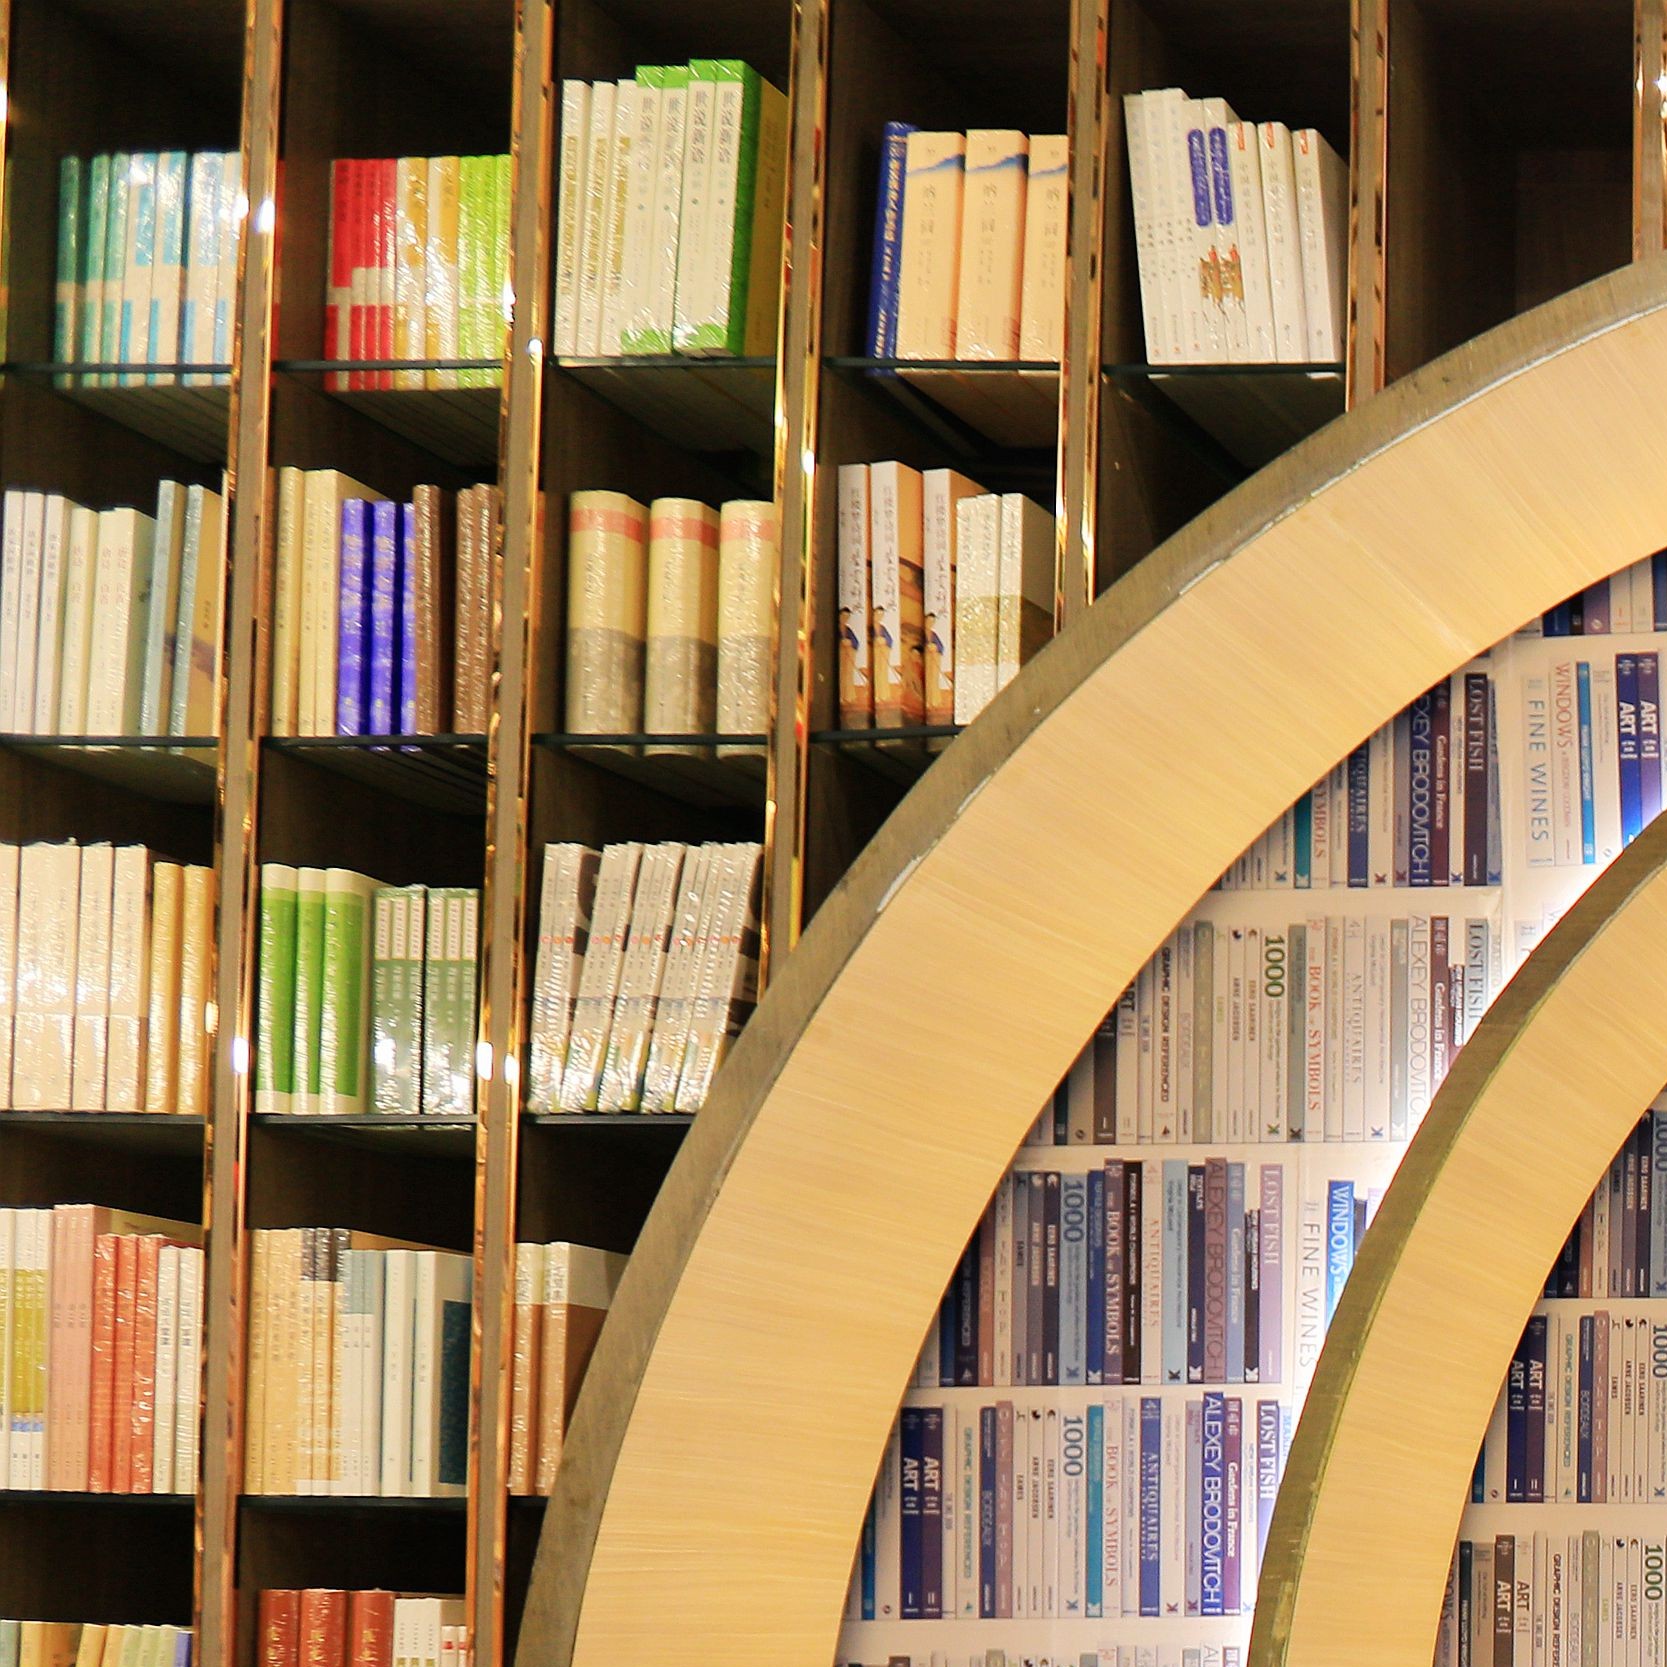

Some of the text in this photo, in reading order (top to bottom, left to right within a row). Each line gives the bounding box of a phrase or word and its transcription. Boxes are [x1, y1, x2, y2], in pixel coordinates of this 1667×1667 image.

[1469, 673, 1485, 770] LOST FISH
[1554, 663, 1572, 748] WINDOWS
[1620, 702, 1636, 736] ART
[1641, 700, 1657, 737] ART
[1529, 699, 1548, 842] FINE WINES
[1265, 936, 1285, 998] 1000
[1309, 965, 1320, 1111] BOOK SYMBOLS
[1106, 1210, 1120, 1355] BOOK SYMBOLS
[1301, 1223, 1320, 1367] FINE WINES
[1064, 1416, 1083, 1476] 1000
[1205, 1394, 1222, 1471] ALEXEY
[904, 1458, 919, 1491] ART
[1227, 1462, 1238, 1506] Gardens
[1497, 1581, 1510, 1612] ART
[1645, 1545, 1663, 1600] 1000
